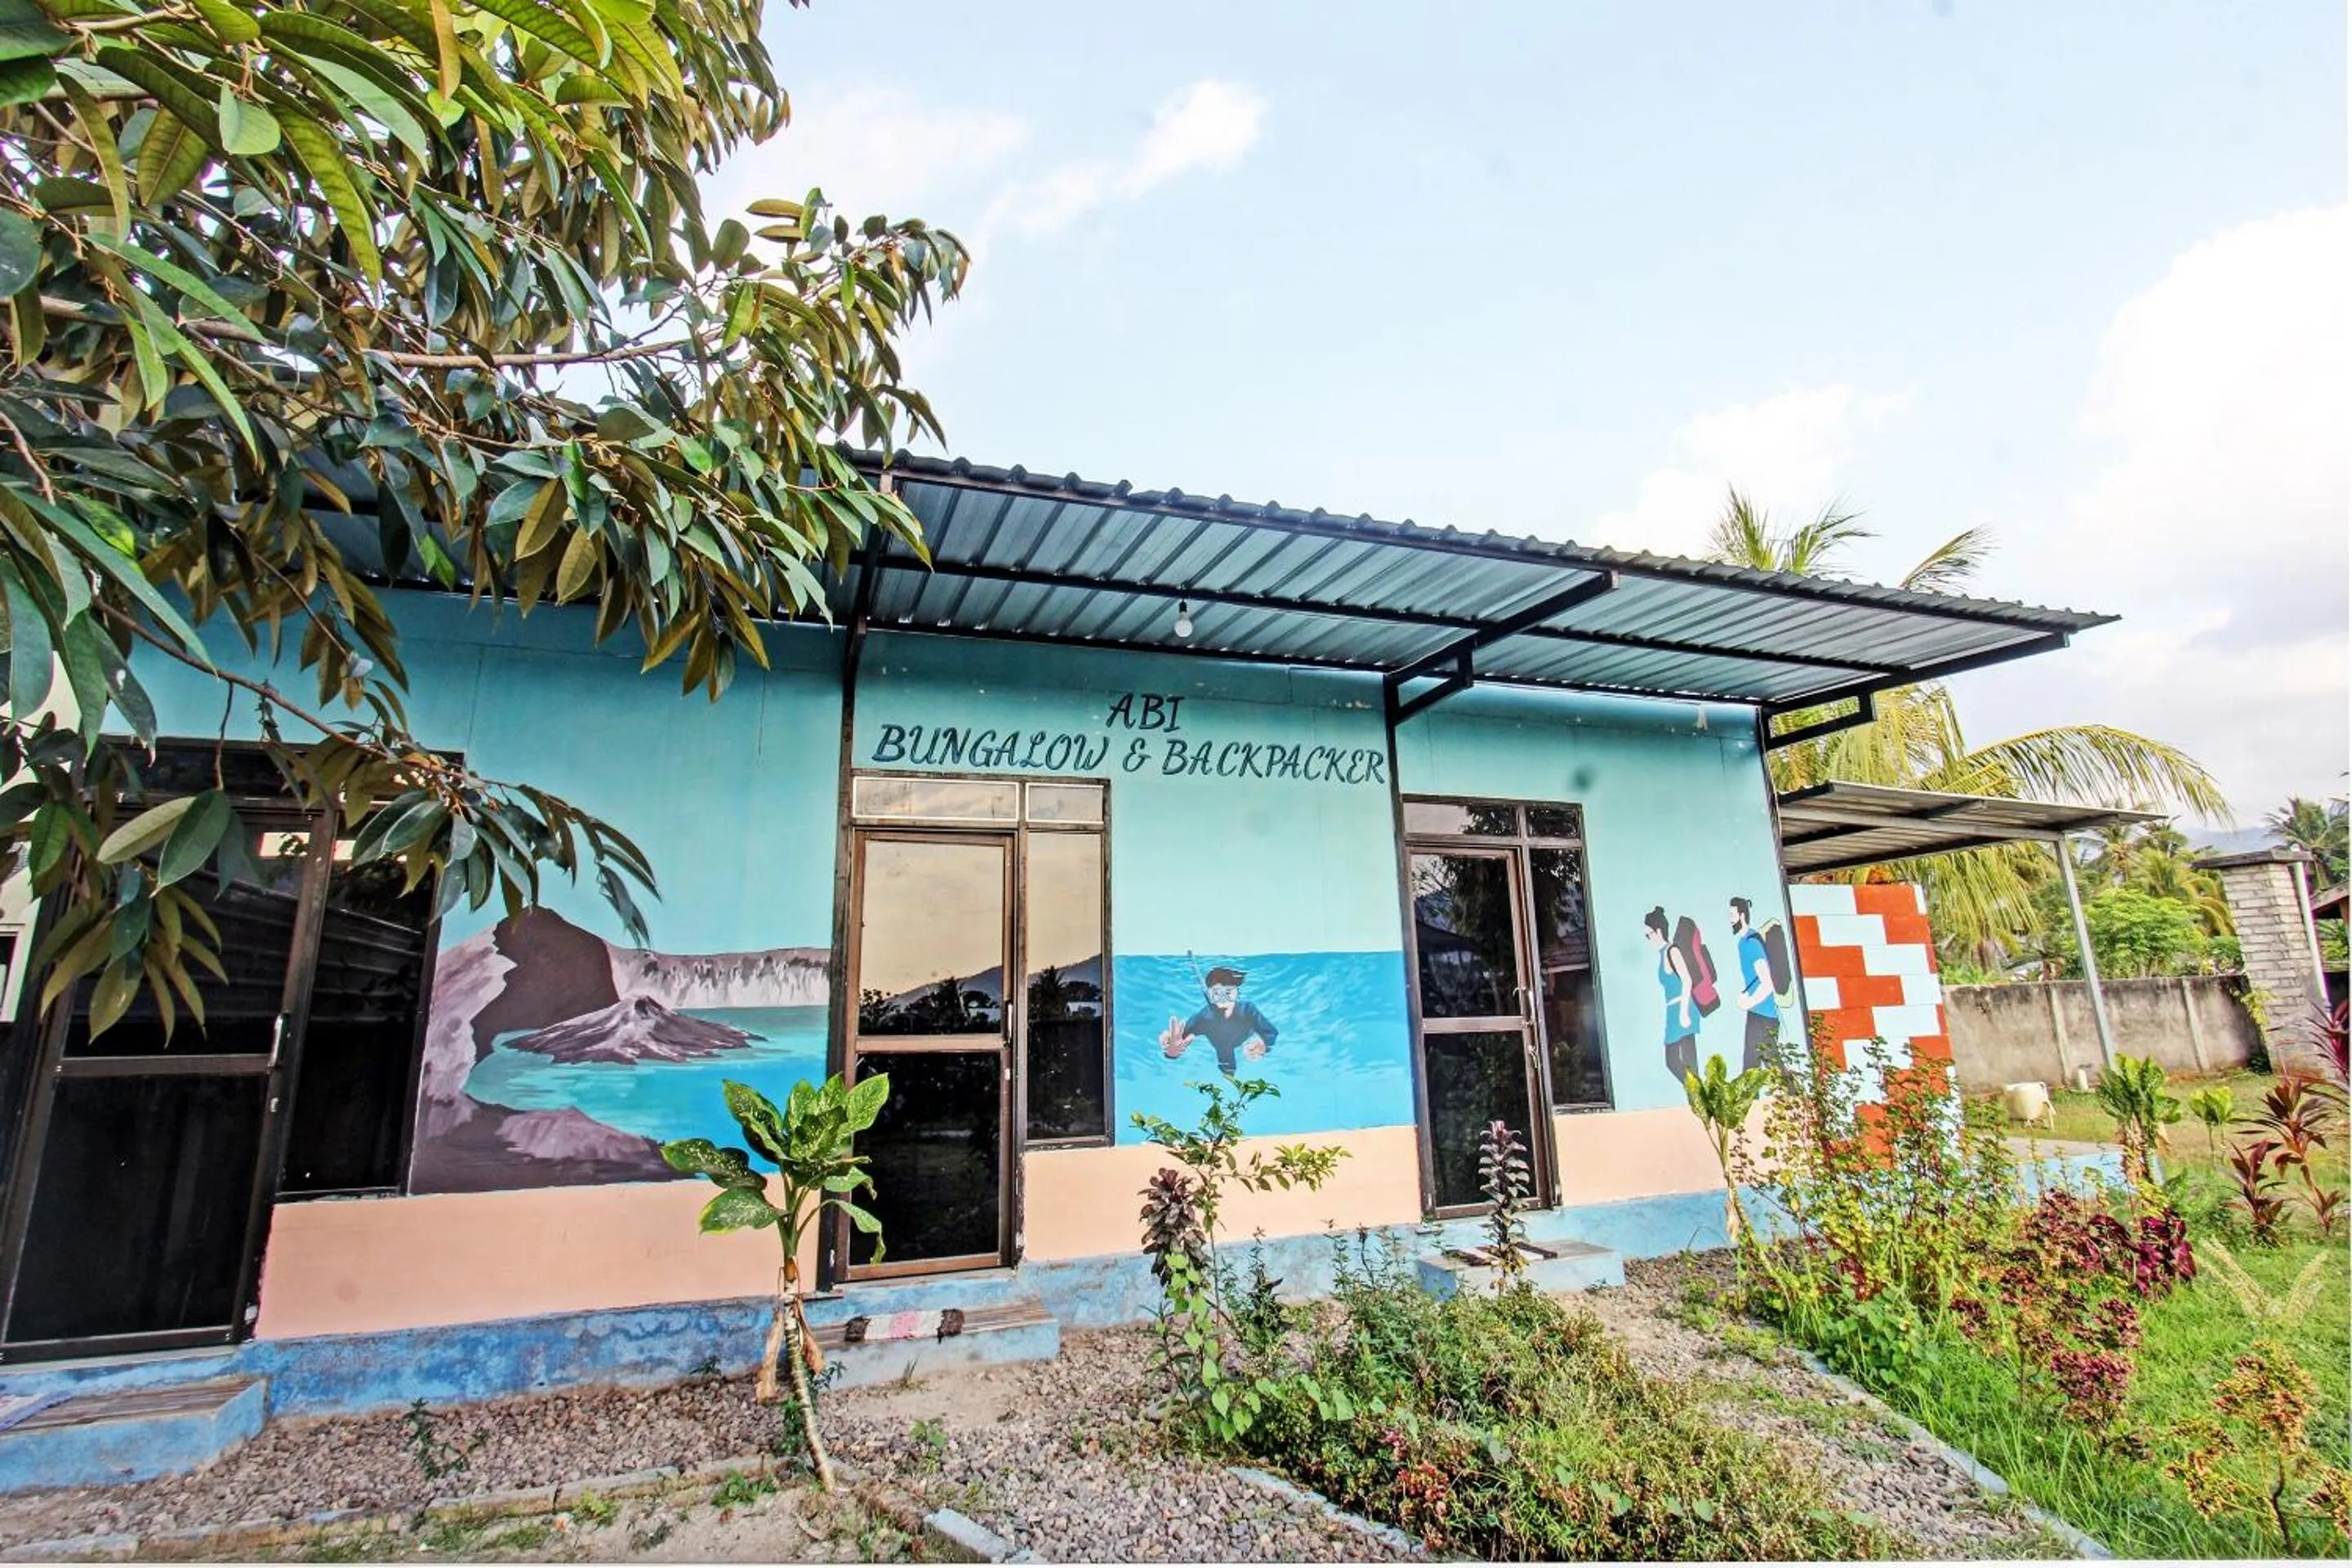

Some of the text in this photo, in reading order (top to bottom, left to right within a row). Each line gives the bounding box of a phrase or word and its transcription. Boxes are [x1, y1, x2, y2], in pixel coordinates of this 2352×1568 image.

[1106, 692, 1185, 731] ABI
[871, 724, 1386, 785] BUNGALOW & BACKPACKER
